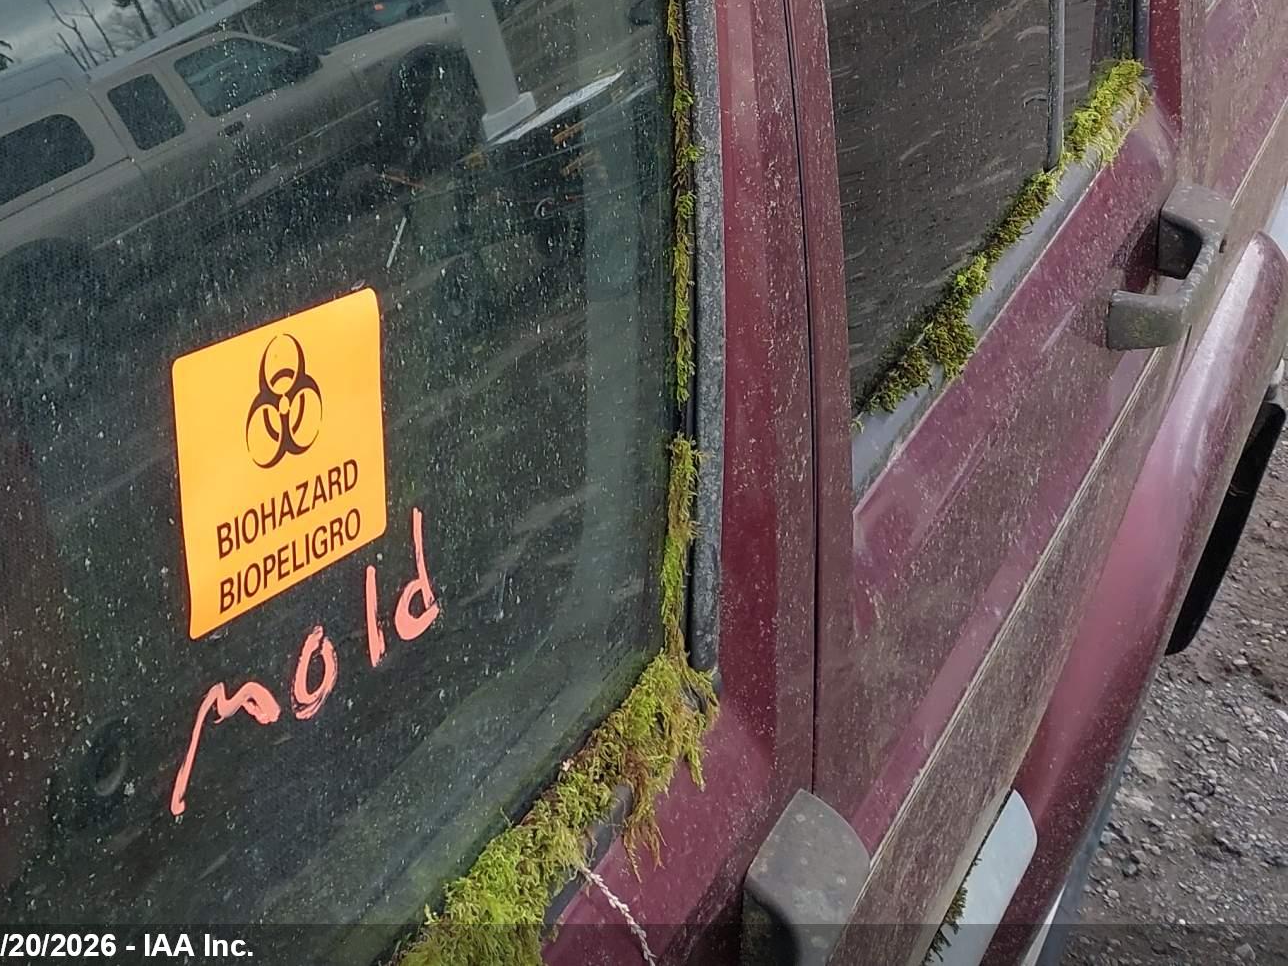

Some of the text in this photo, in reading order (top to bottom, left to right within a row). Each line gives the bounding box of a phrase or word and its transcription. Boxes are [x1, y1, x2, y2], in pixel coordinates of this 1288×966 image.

[217, 458, 359, 559] BIOHAZARD
[219, 507, 362, 614] BIOPELIGRO
[171, 507, 440, 815] mold
